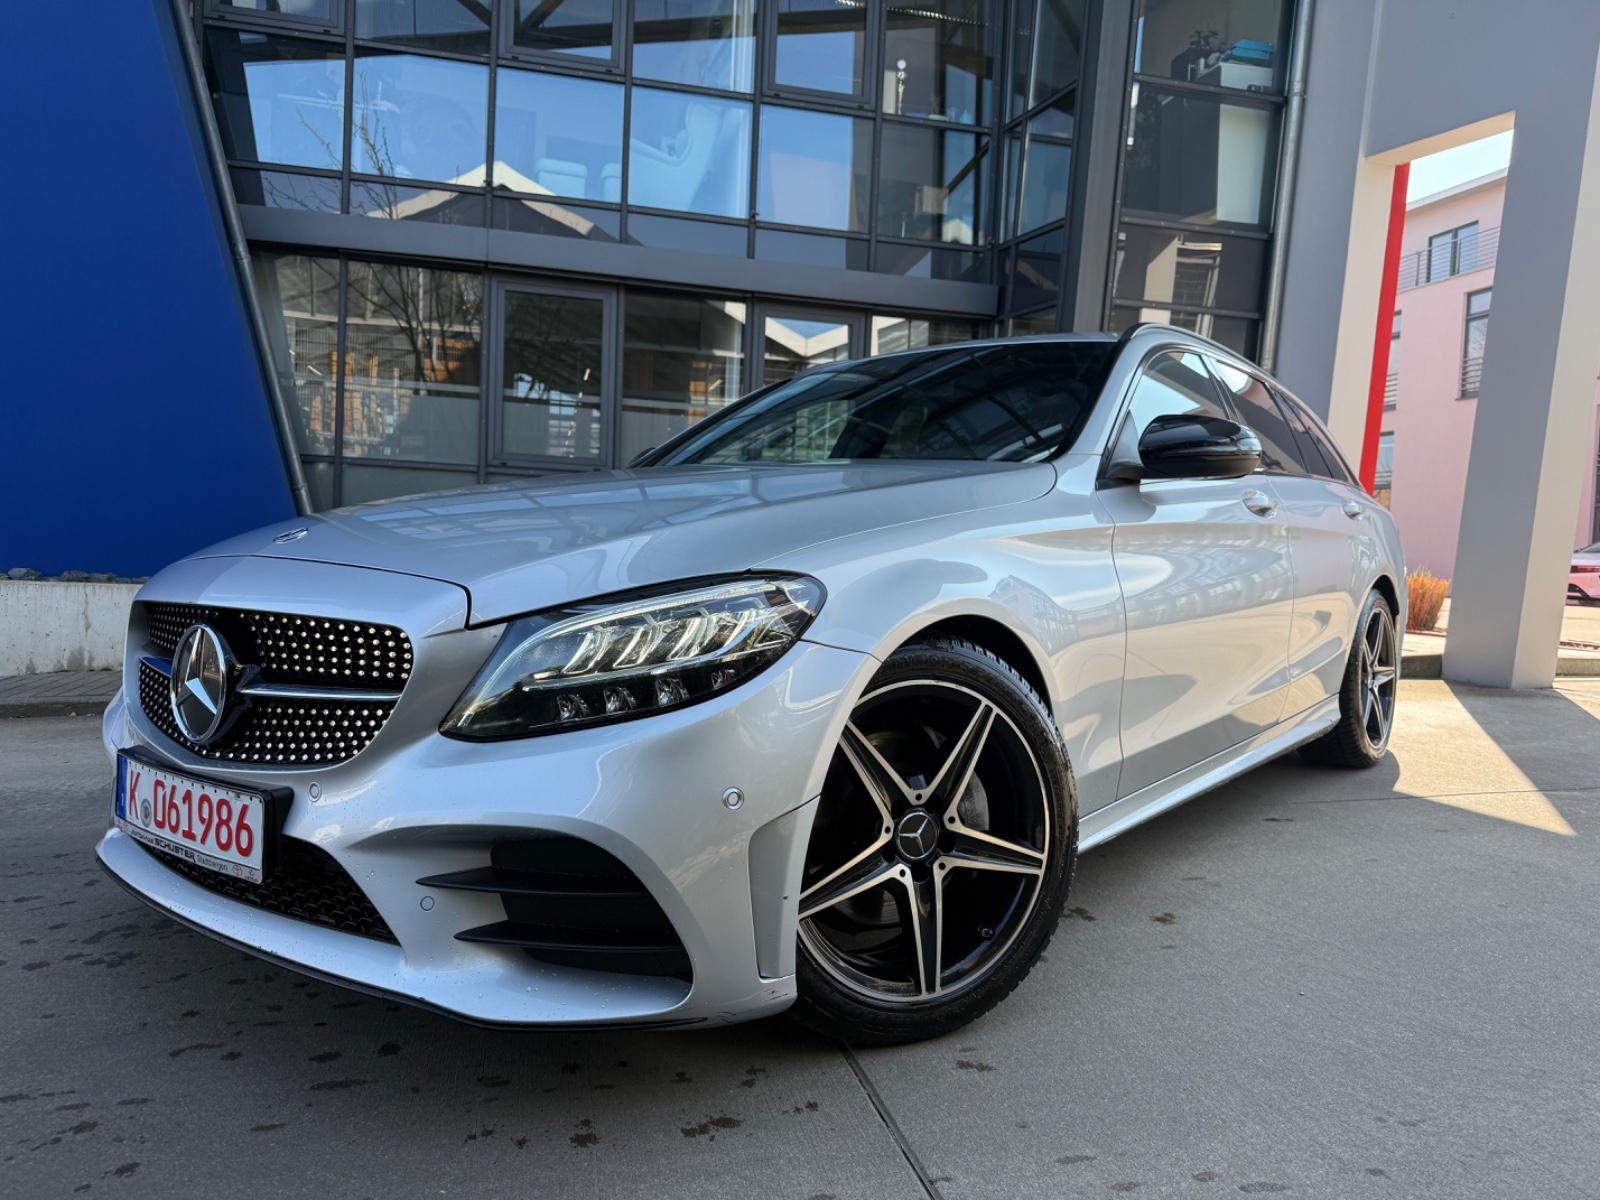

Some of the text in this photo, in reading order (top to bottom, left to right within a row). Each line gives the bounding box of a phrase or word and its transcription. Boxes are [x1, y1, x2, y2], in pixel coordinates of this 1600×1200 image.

[129, 769, 254, 857] K 061986
[154, 837, 195, 859] SCHUSTER
